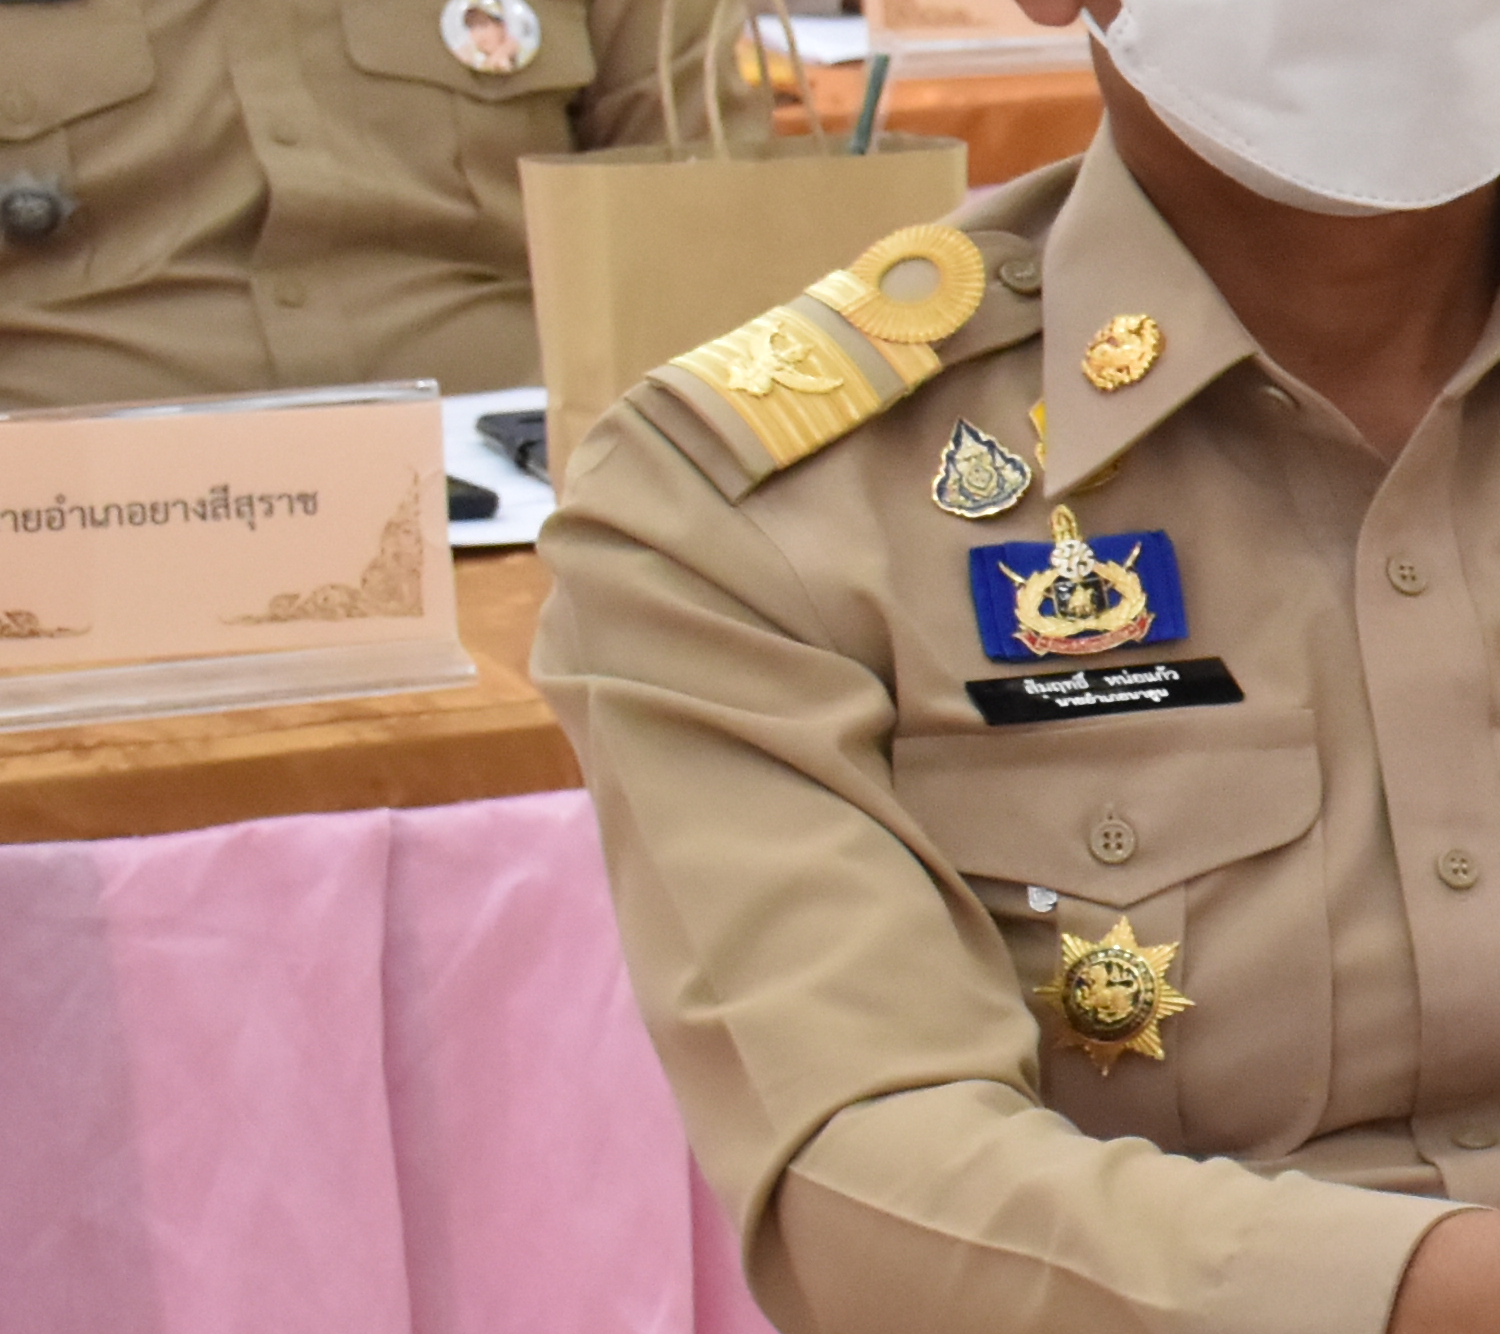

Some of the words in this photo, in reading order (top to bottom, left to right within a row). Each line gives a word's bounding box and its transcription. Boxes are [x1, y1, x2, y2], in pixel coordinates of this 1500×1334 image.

[0, 483, 319, 533] ายอำเภอยางสีสุราช
